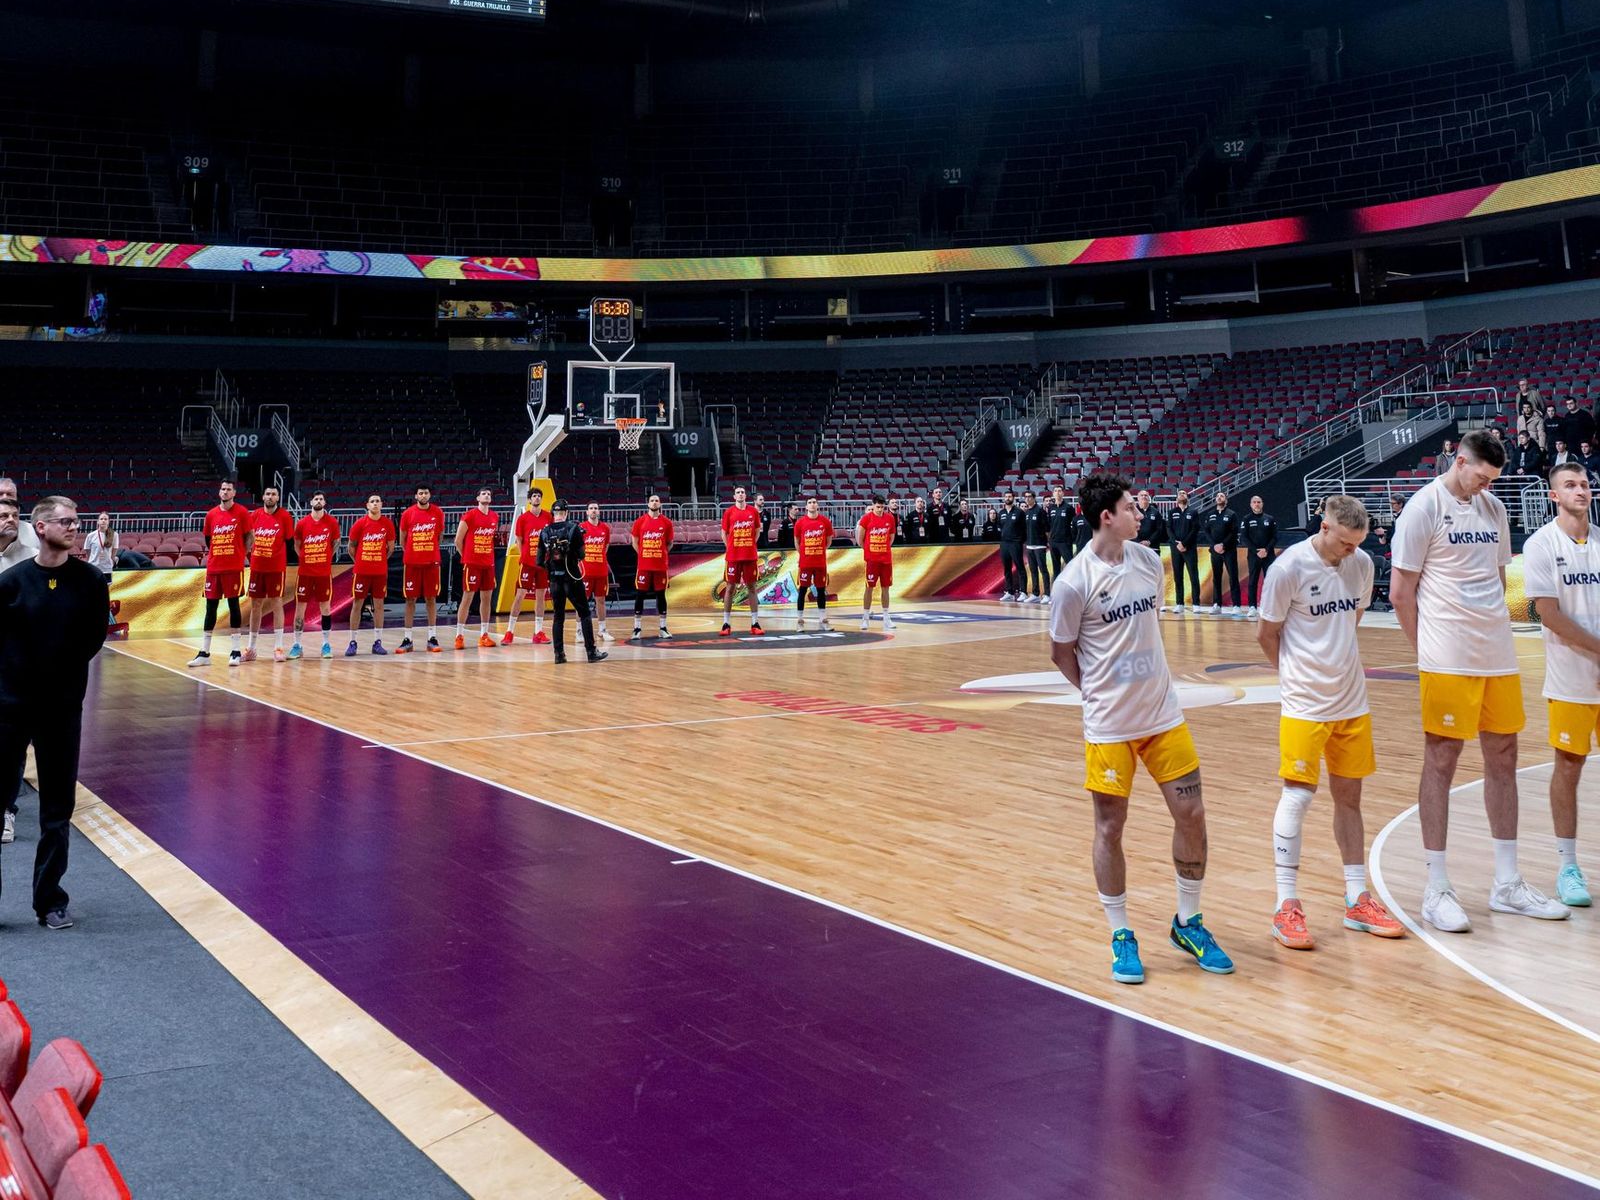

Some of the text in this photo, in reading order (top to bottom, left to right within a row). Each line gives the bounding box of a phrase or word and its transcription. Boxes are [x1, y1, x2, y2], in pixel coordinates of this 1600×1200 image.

[1224, 140, 1244, 152] 312
[184, 156, 208, 168] 309
[943, 168, 960, 179] 311
[602, 178, 621, 188] 310
[1009, 424, 1031, 438] 110
[1392, 428, 1412, 444] 111
[230, 434, 258, 448] 108
[672, 433, 698, 445] 109
[1448, 532, 1498, 544] UKRAINE
